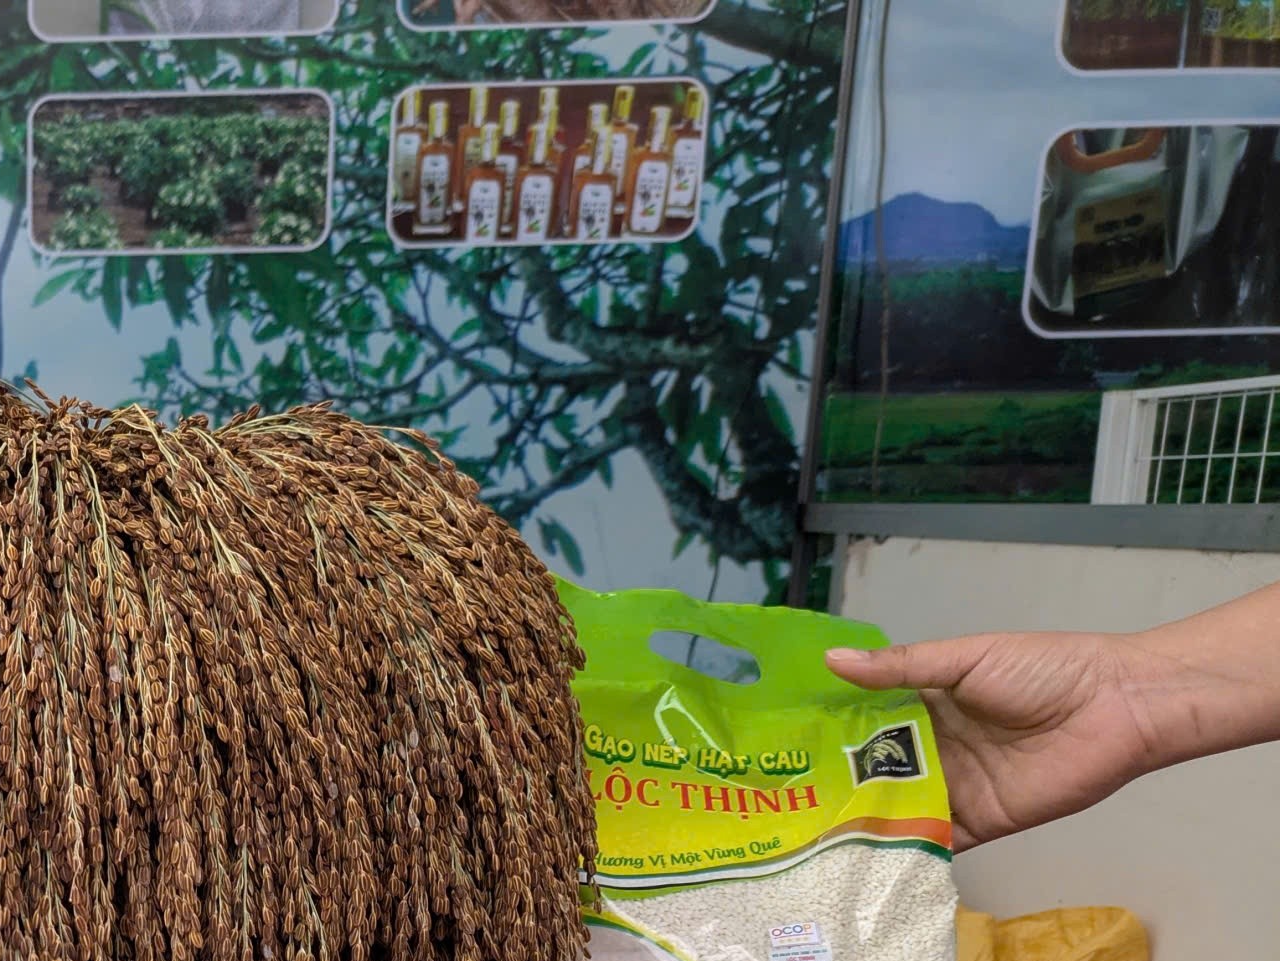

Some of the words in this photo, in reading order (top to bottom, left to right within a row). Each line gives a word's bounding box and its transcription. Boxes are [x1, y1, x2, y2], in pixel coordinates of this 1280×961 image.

[584, 724, 635, 763] GẠO
[643, 736, 690, 768] NẾP
[698, 749, 751, 777] HẠT
[758, 750, 809, 774] CAU
[671, 782, 820, 820] THỊNH
[648, 854, 666, 869] Vị
[671, 851, 702, 867] Một
[704, 845, 746, 862] Vùng
[749, 837, 782, 856] Quê
[771, 922, 812, 937] OCOP
